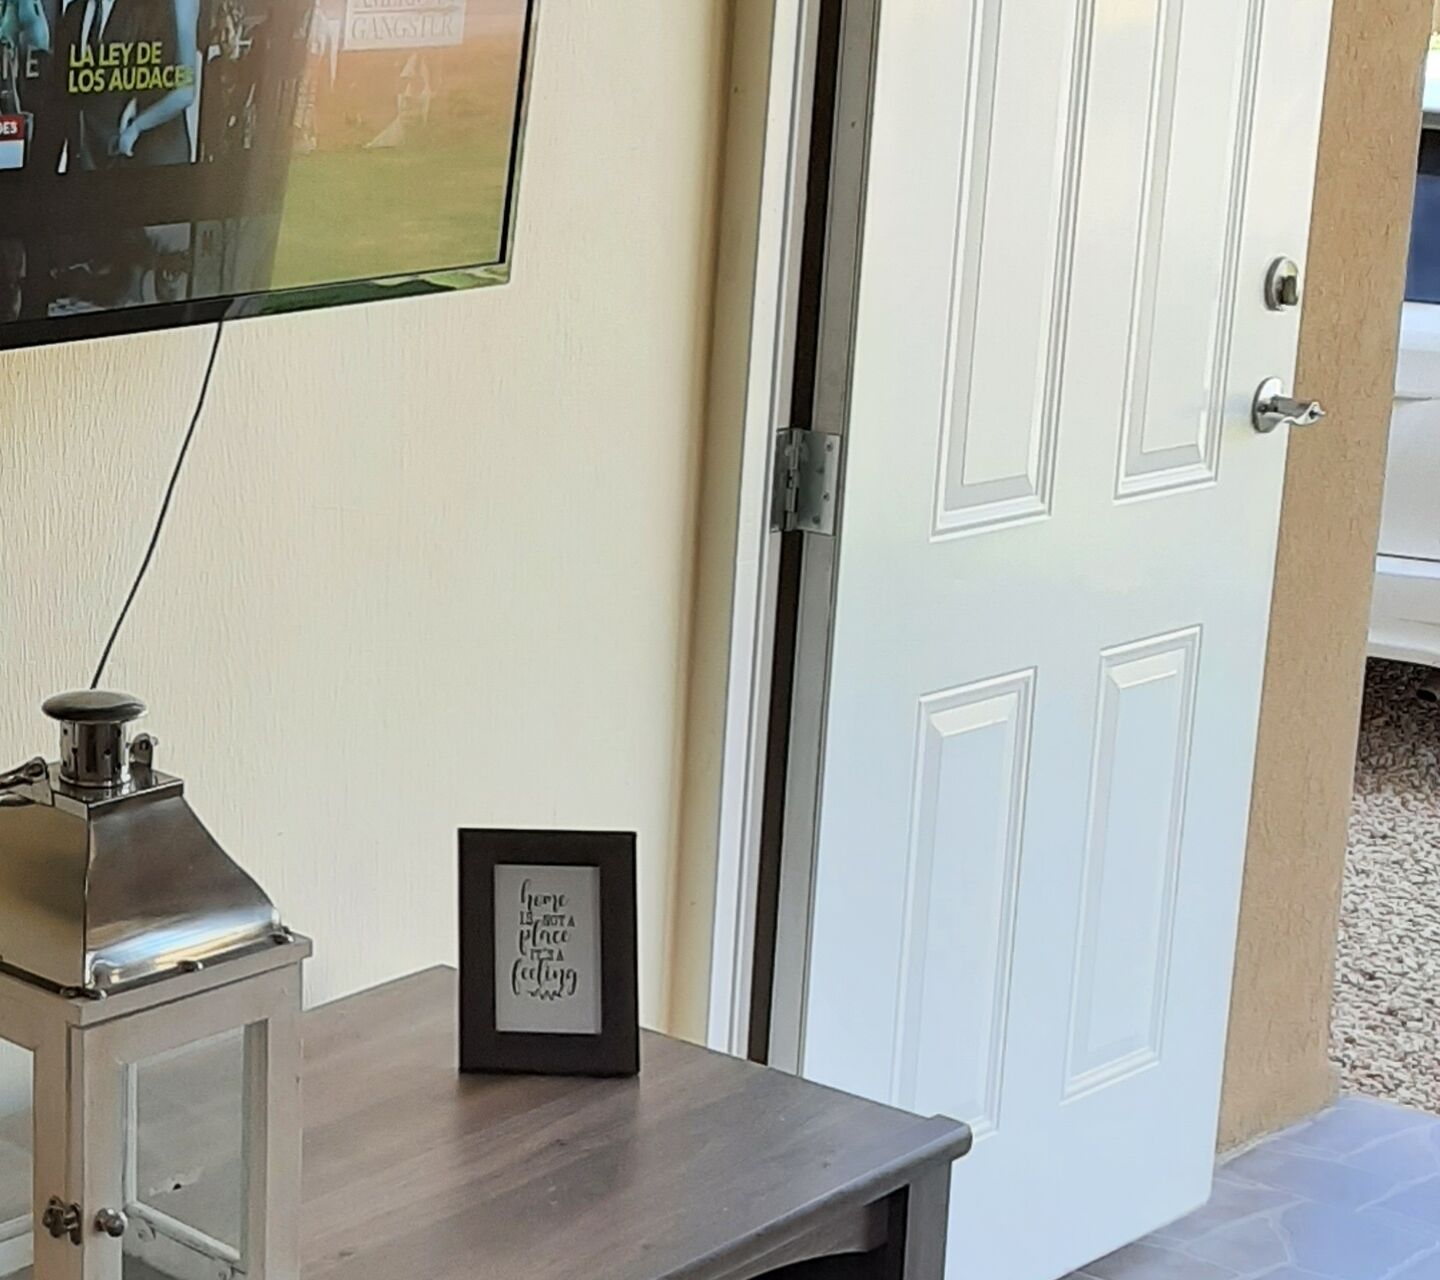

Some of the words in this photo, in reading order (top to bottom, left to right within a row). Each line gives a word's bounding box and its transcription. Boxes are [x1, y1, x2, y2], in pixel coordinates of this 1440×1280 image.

[351, 13, 456, 43] GANGSTER
[70, 43, 93, 69] LA
[98, 41, 132, 68] LEY
[136, 41, 163, 65] DE
[69, 69, 106, 94] LOS
[518, 919, 573, 956] place
[511, 957, 579, 997] feeling
